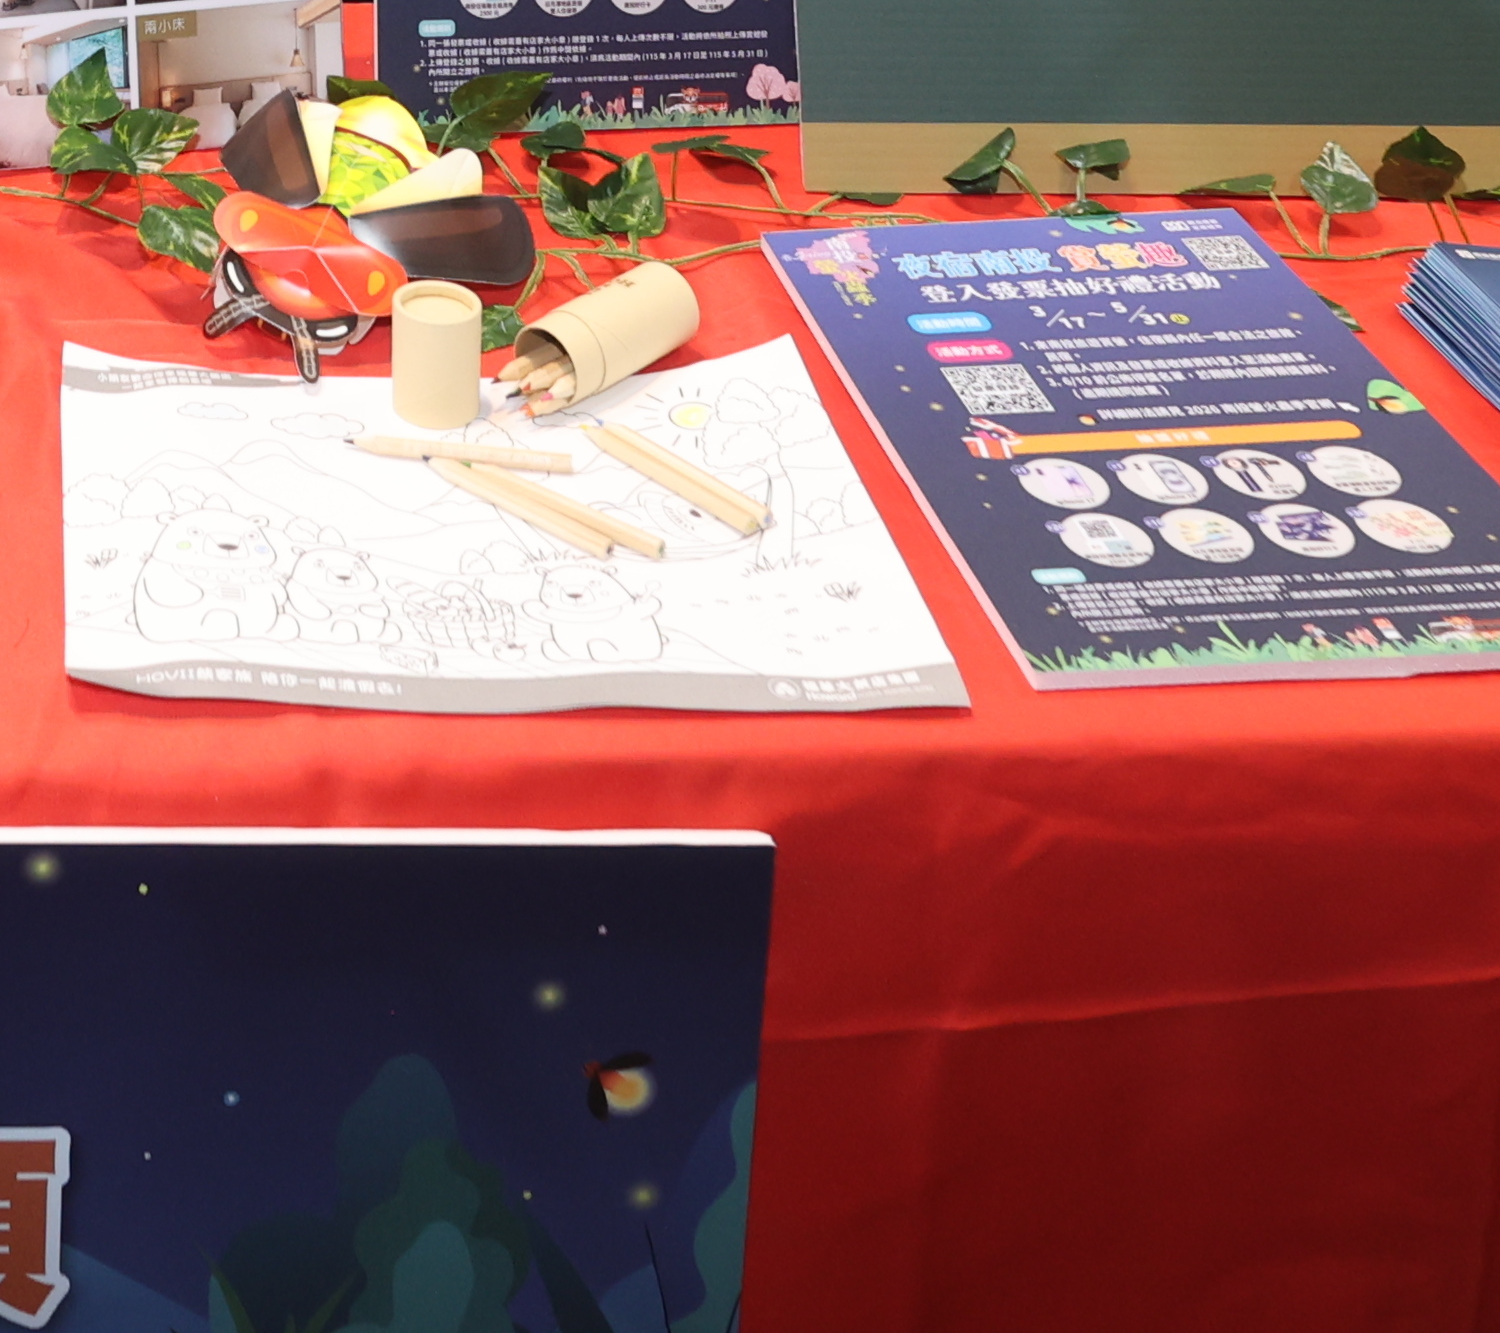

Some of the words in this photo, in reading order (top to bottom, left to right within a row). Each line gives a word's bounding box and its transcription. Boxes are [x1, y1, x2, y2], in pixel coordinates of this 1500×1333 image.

[144, 16, 187, 34] 兩小床
[892, 247, 1063, 279] 夜宿南投
[1057, 240, 1190, 274] 賞螢趣
[919, 270, 1224, 304] 登入發票抽好禮活動
